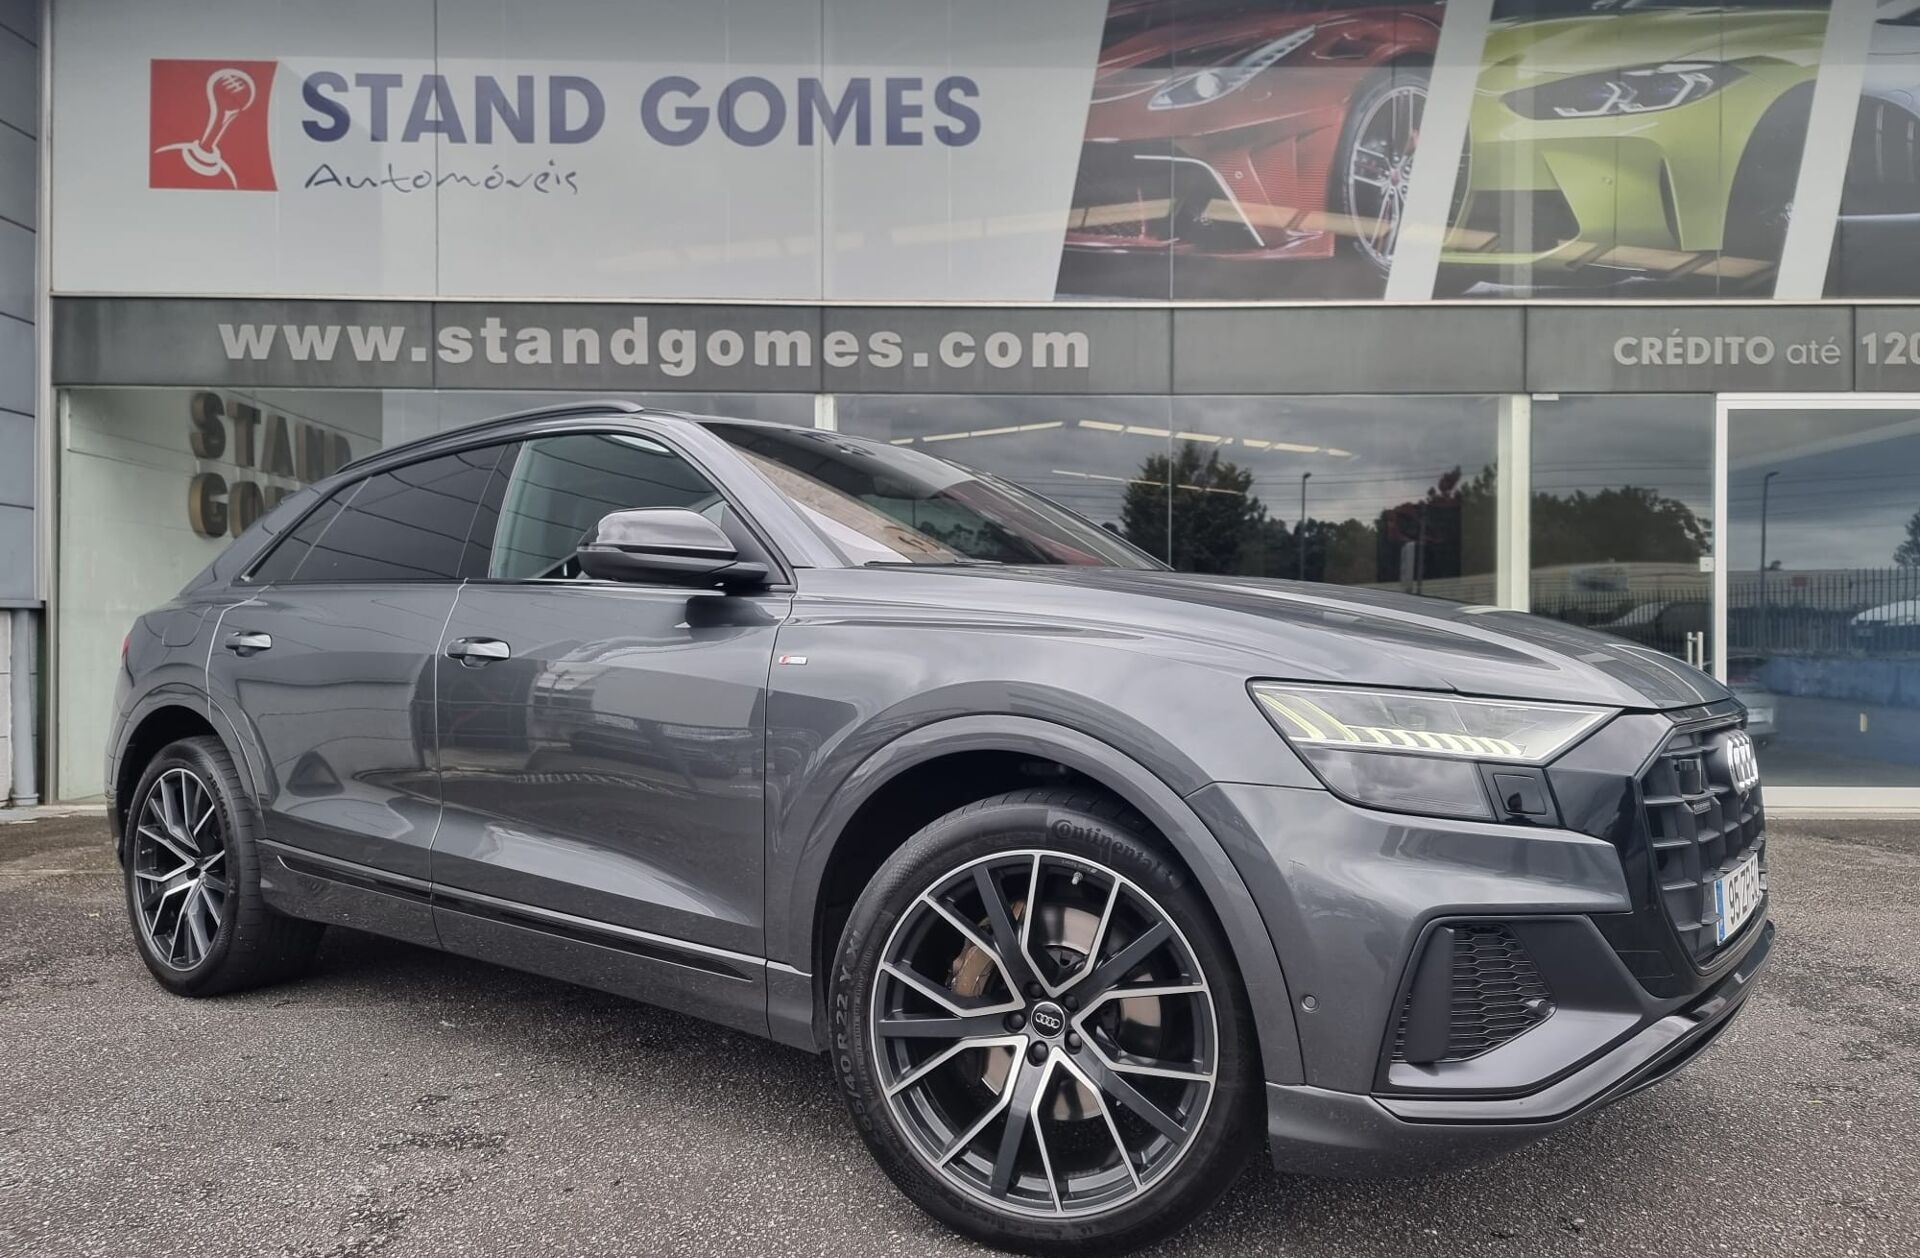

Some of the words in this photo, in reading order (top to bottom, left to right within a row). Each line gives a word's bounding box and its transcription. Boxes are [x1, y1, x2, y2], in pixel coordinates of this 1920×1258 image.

[302, 71, 606, 145] STAND
[640, 75, 982, 147] GOMES
[305, 160, 578, 195] Automóveis
[218, 316, 1090, 377] www.standgomes.com
[1613, 328, 1776, 366] CRÉDITO
[1786, 336, 1842, 365] até
